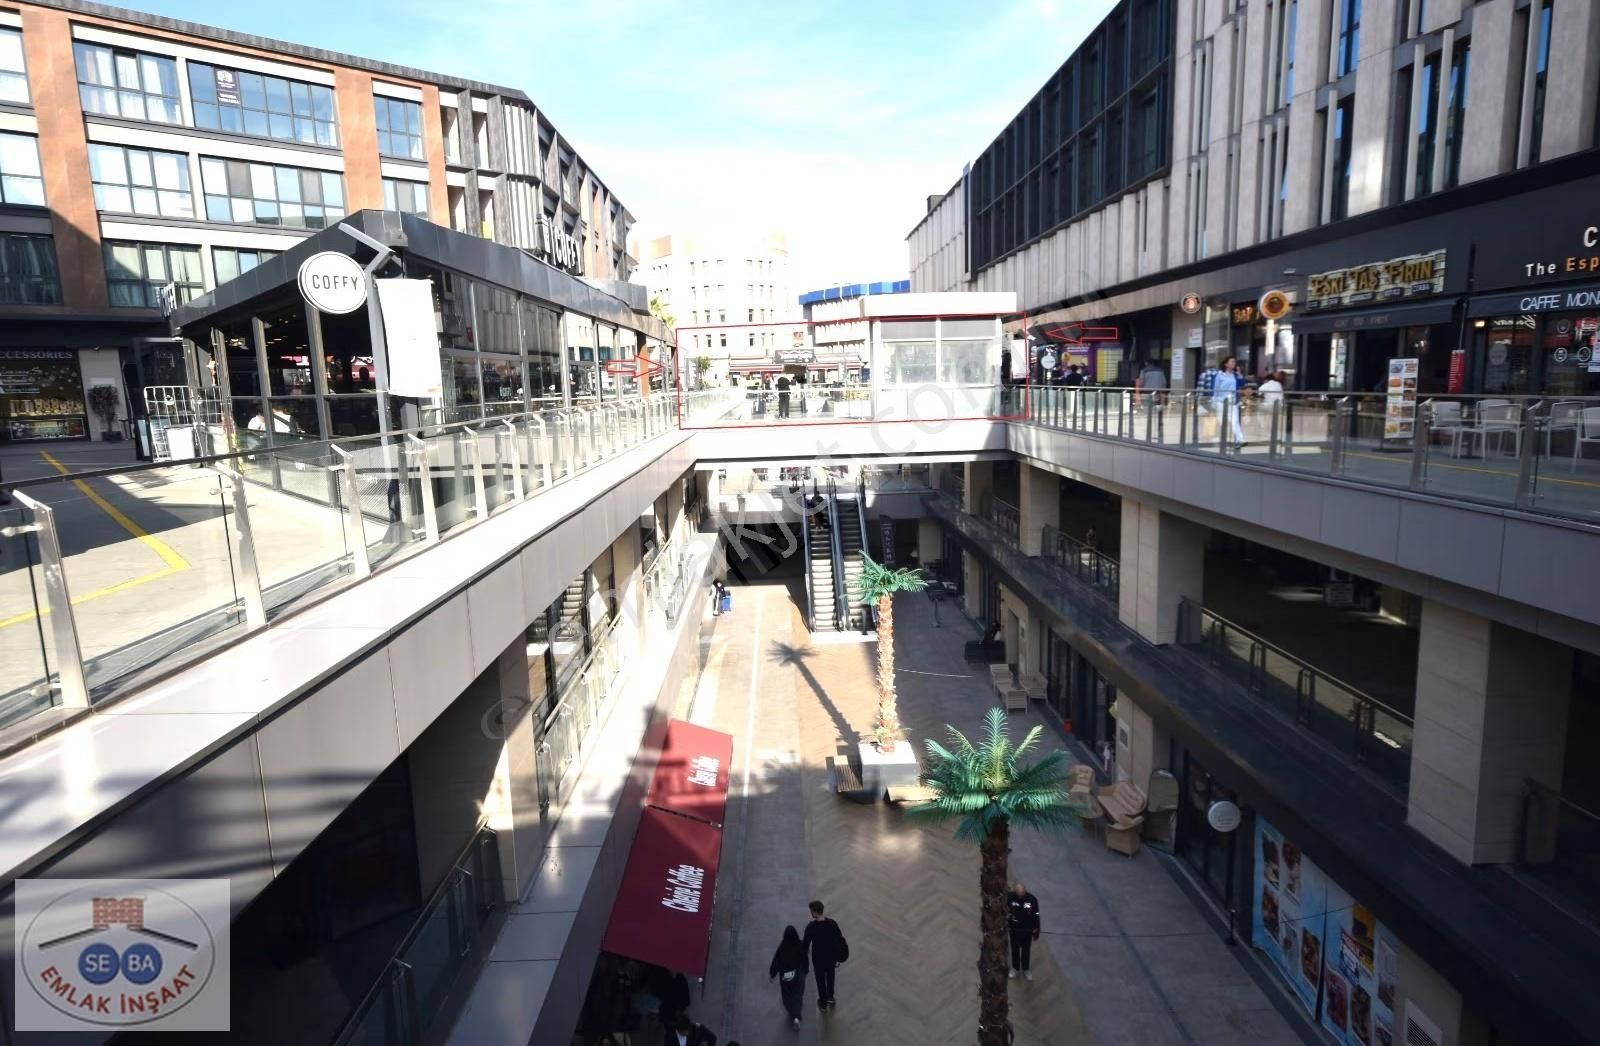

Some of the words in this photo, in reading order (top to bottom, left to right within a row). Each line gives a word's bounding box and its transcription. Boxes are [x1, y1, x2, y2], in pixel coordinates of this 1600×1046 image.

[1383, 259, 1433, 284] FIRIN
[1525, 262, 1557, 277] The
[1565, 256, 1600, 272] Esp
[311, 274, 358, 291] COFFY
[1520, 294, 1561, 311] CAFFE
[1566, 290, 1600, 307] MON
